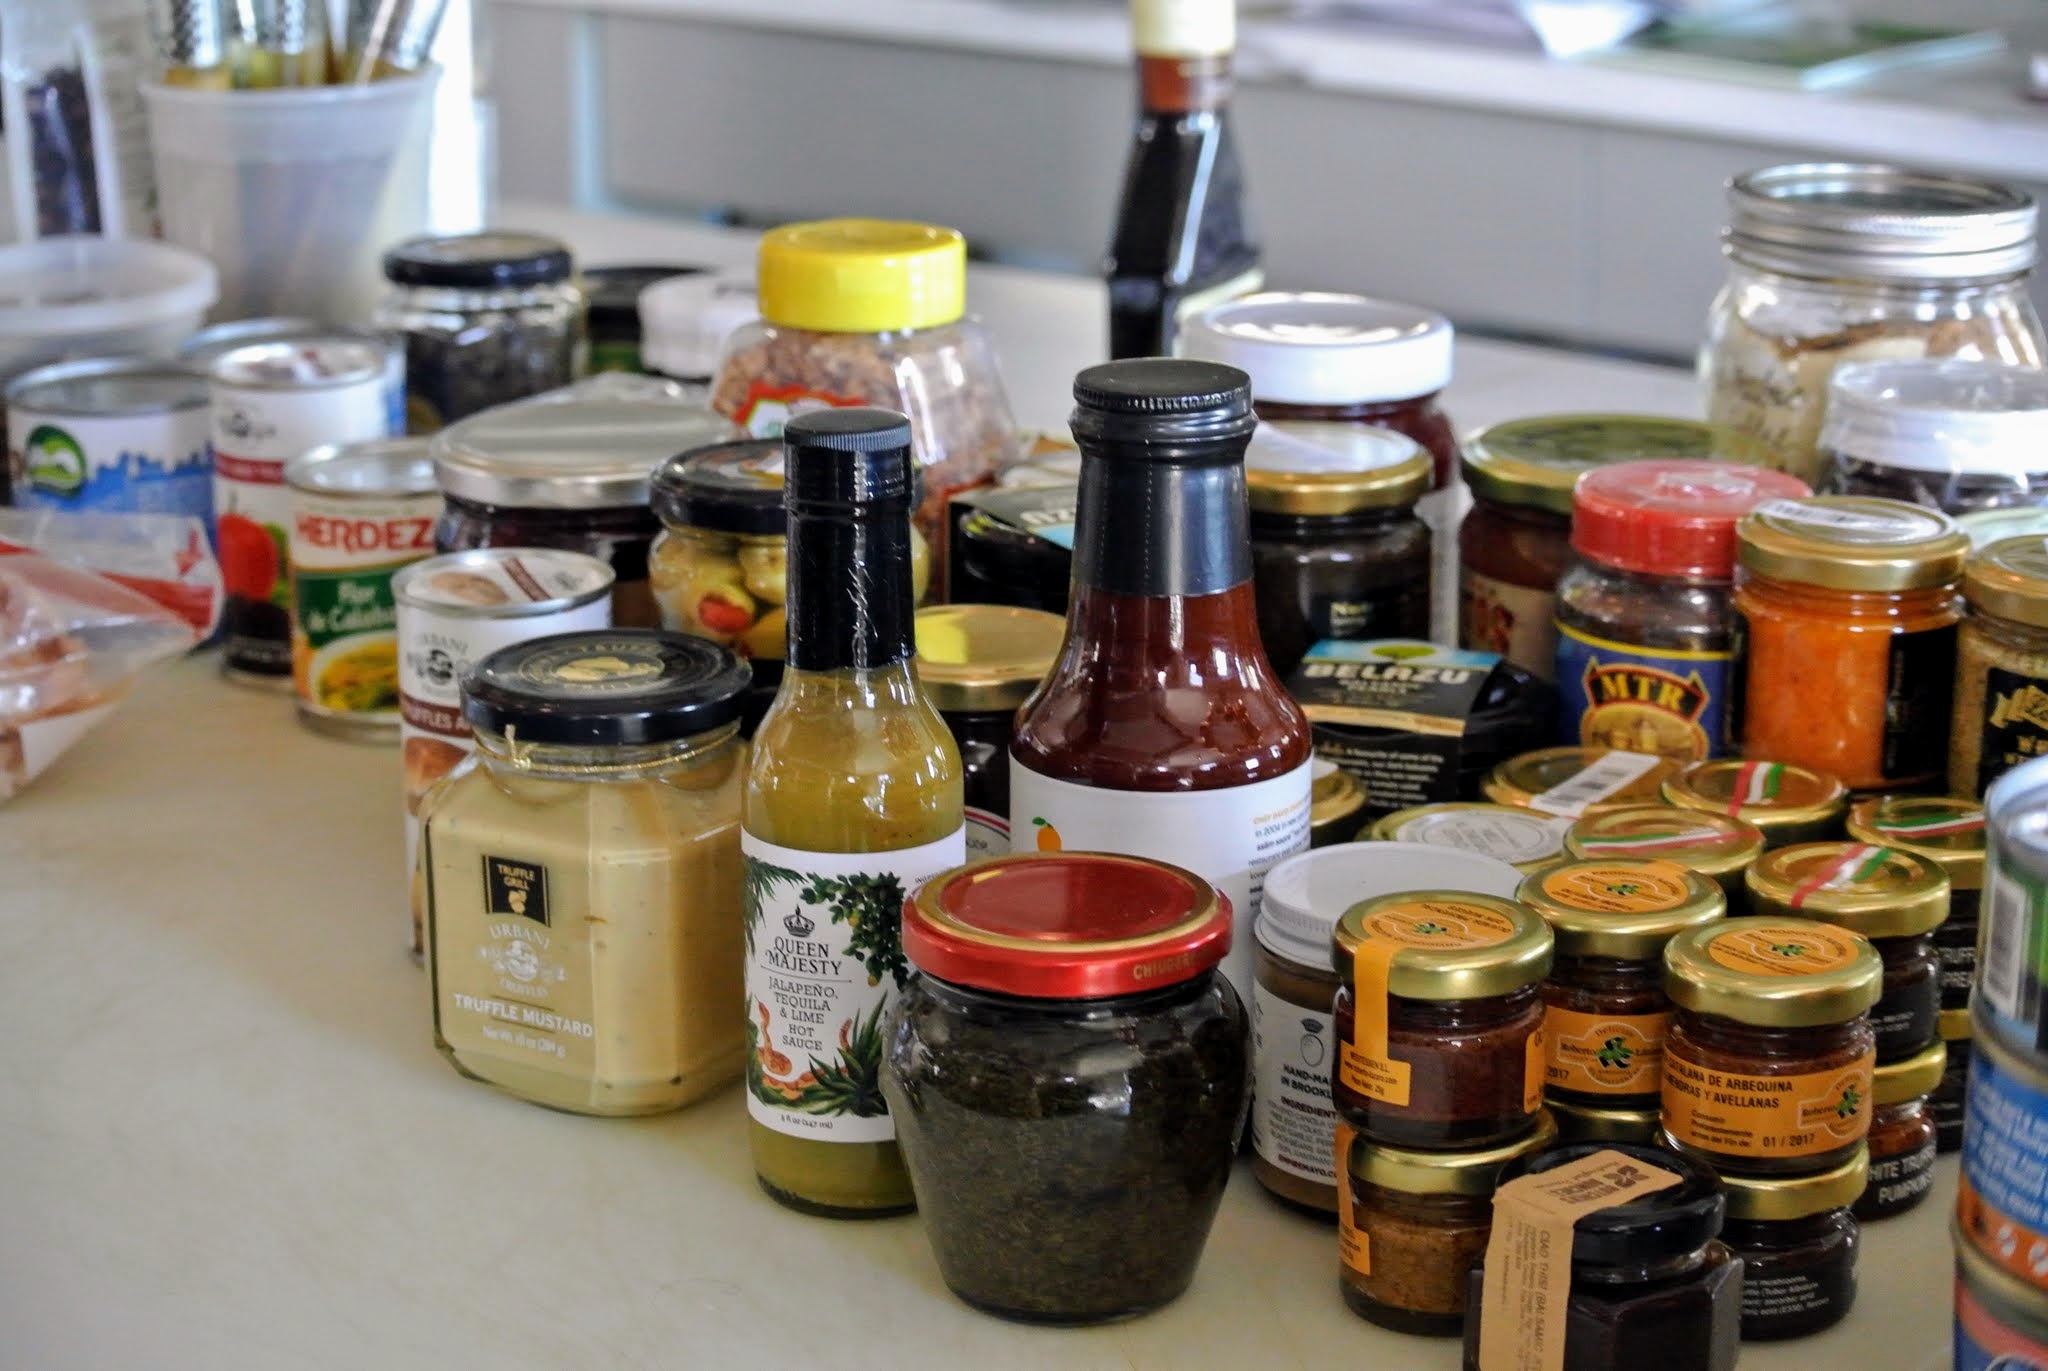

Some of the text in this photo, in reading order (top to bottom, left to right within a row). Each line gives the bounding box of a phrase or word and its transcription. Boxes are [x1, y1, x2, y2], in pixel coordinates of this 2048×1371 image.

[297, 516, 434, 555] HERDEZ
[1304, 663, 1470, 685] BELAZU
[1602, 672, 1684, 710] MTR
[498, 864, 535, 881] TRUFFLE
[504, 876, 530, 891] GRILL
[490, 924, 550, 950] URBANI
[774, 936, 829, 958] QUEEN
[766, 949, 842, 976] MAJESTY
[769, 976, 839, 999] JALAPEÑO,
[774, 992, 831, 1011] TEQUILA
[454, 993, 593, 1038] TRUFFLE MUSTARD
[780, 1007, 824, 1025] & LIME
[789, 1023, 814, 1037] HOT
[782, 1035, 823, 1051] SAUCE
[1283, 1063, 1331, 1086] HAND-MA
[1709, 1073, 1721, 1088] DE
[1725, 1078, 1793, 1093] ARBEQUINA
[1281, 1076, 1333, 1100] IN BROOKL
[1281, 1096, 1337, 1120] INGREDIENT
[1713, 1092, 1780, 1109] AVELLANAS
[1763, 1135, 1776, 1148] 01
[1789, 1133, 1815, 1147] 2017
[1539, 1230, 1552, 1258] CIAO
